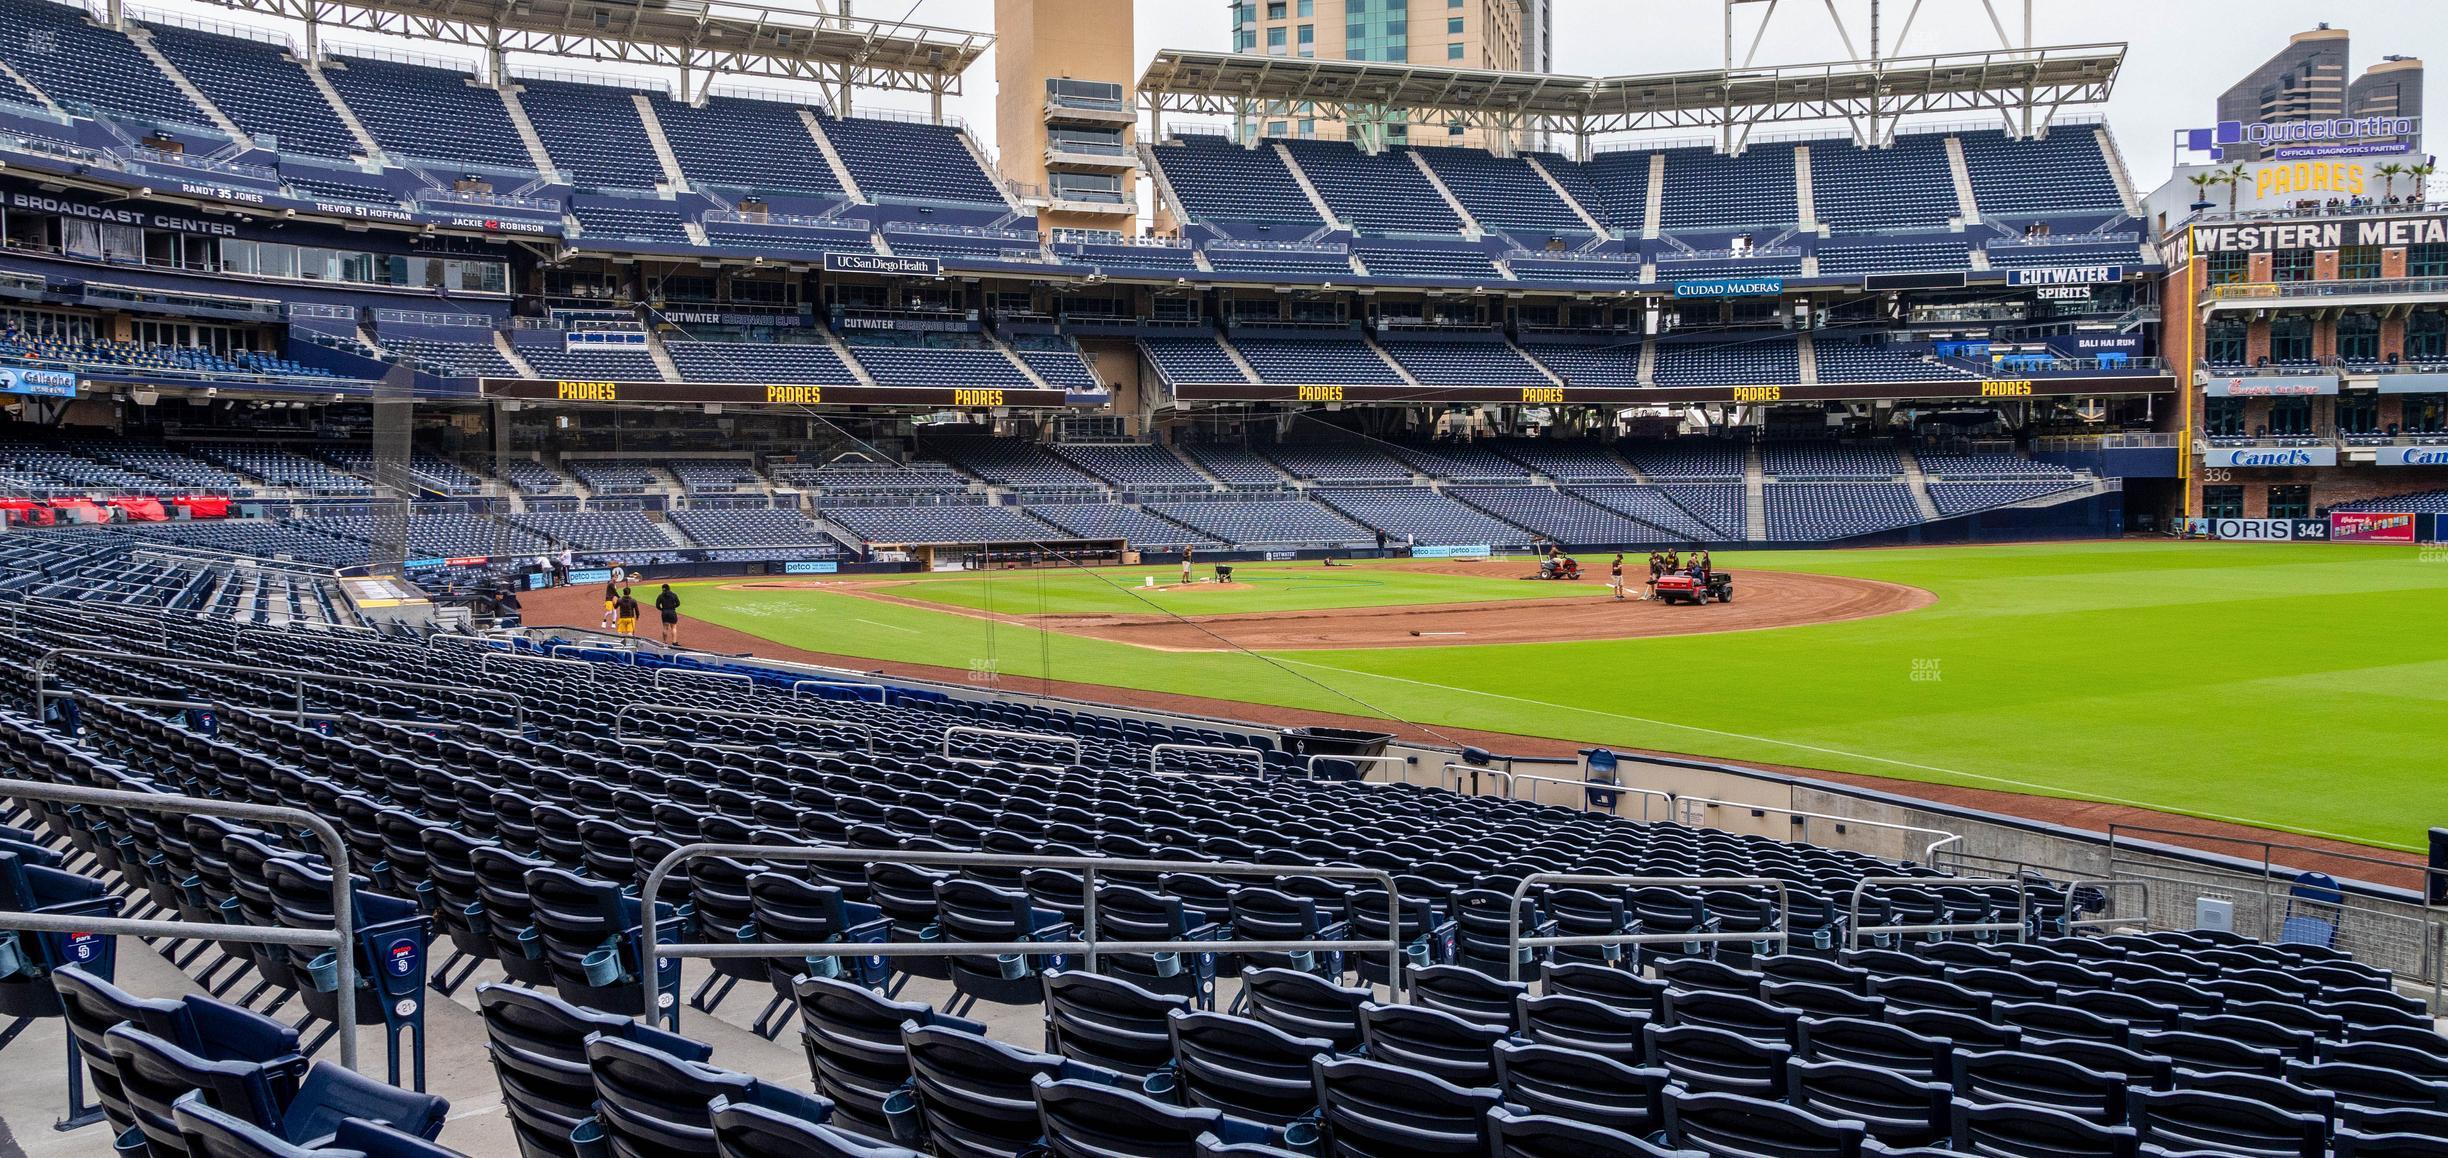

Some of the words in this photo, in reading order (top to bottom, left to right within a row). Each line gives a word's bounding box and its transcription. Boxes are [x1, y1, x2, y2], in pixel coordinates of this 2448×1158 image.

[2247, 116, 2412, 146] QuidelOrtho
[2281, 149, 2315, 157] OFFICIAL
[2317, 146, 2369, 156] DIAGNOSTICS
[2370, 144, 2406, 153] PARTNER
[2256, 162, 2364, 200] PADRES
[182, 184, 215, 196] RANDY
[218, 188, 232, 200] 35
[234, 191, 264, 203] JONES
[14, 193, 144, 225] BROADCAST
[154, 215, 236, 236] CENTER
[315, 202, 352, 214] TREVOR
[355, 206, 367, 216] 51
[370, 209, 412, 221] HOFFMAN
[452, 218, 483, 228] JACKIE
[484, 219, 498, 230] 42
[500, 222, 544, 233] ROBINSON
[2193, 223, 2341, 252] WESTERN
[2359, 218, 2448, 246] META
[837, 256, 853, 267] UC
[853, 258, 872, 268] San
[873, 258, 898, 271] Diego
[899, 260, 928, 271] Health
[2019, 267, 2109, 284] CUTWATER
[1678, 285, 1724, 295] CIUDAD
[1727, 282, 1780, 294] MADERAS
[2037, 286, 2091, 299] SPIRITS
[665, 311, 720, 323] CUTWATER
[844, 318, 894, 329] CUTWATER
[2079, 339, 2099, 348] BALI
[2117, 339, 2136, 347] RUM
[558, 380, 616, 401] PADRES
[767, 385, 821, 405] PADRES
[1299, 385, 1343, 401] PADRES
[1522, 387, 1564, 403] PADRES
[1734, 385, 1780, 402] PADRES
[1981, 380, 2032, 397] PADRES
[955, 389, 1003, 407] PADRES
[2229, 449, 2312, 466] Canel's
[2204, 468, 2231, 482] 336
[2219, 520, 2288, 539] ORIS
[2298, 523, 2325, 538] 342
[787, 563, 811, 571] petco
[570, 572, 590, 581] petco
[402, 1003, 412, 1013] 21
